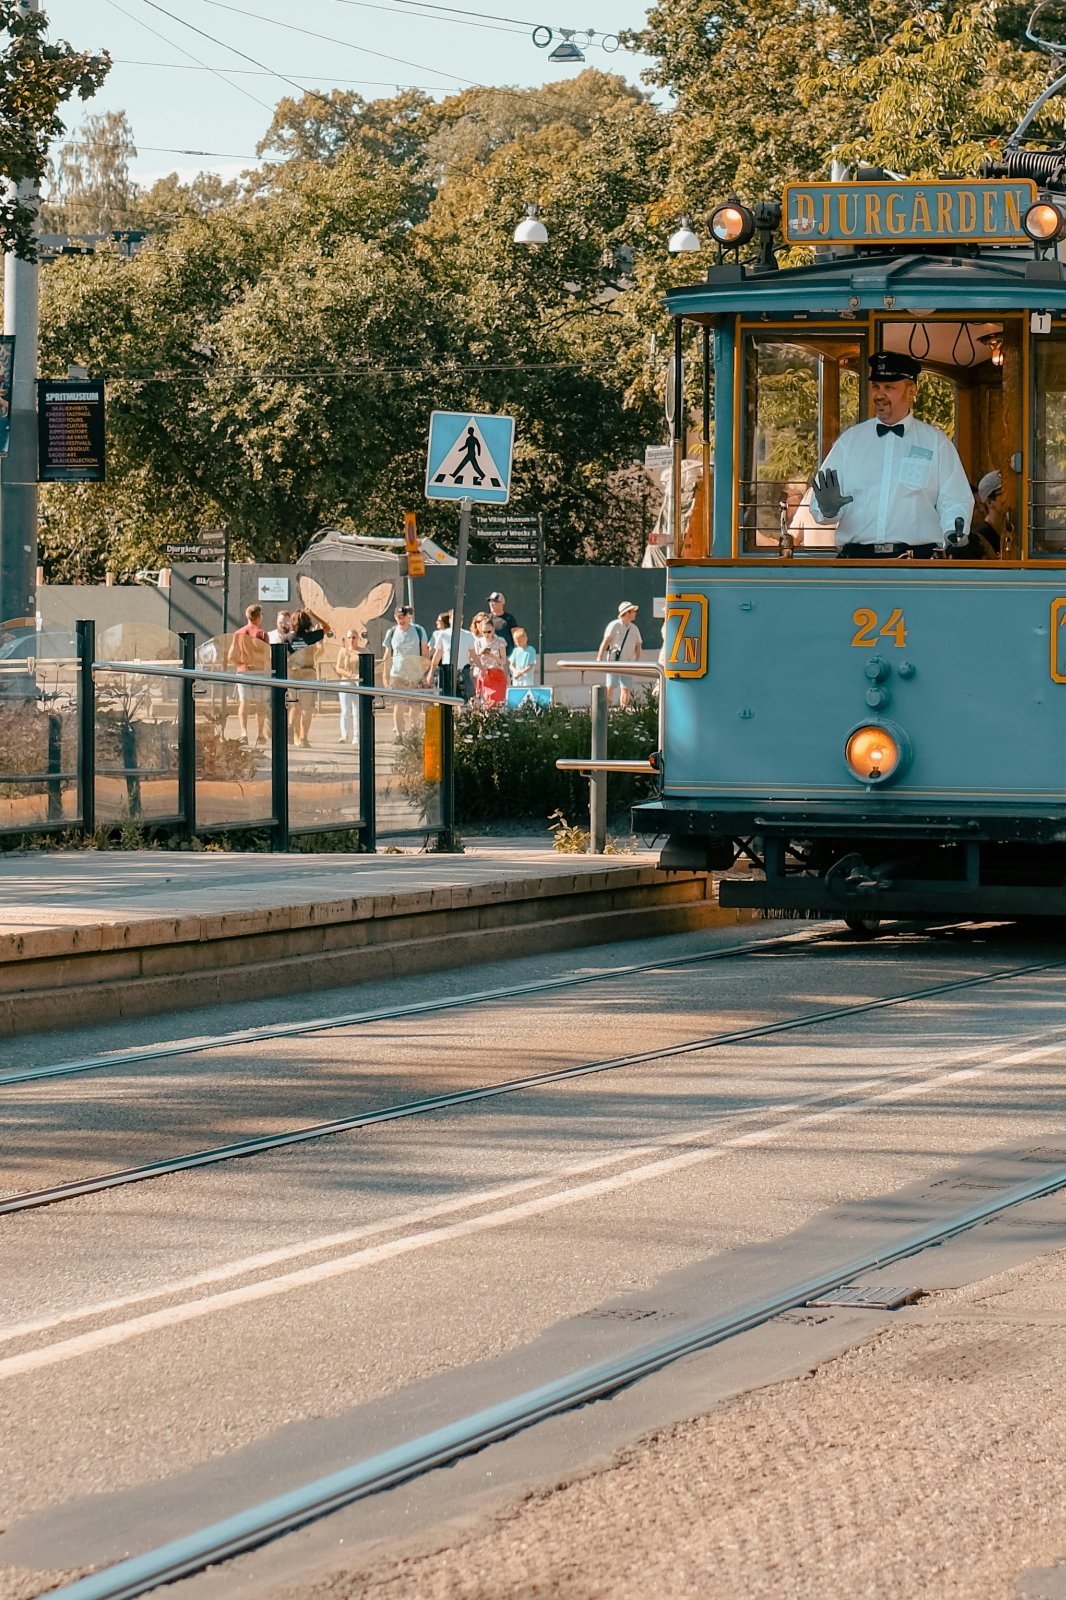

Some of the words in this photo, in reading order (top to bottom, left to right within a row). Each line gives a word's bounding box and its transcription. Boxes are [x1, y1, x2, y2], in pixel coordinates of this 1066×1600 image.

[796, 190, 1024, 237] DJURGÅRDEN
[45, 392, 99, 401] SPRITMUSEUM
[488, 516, 506, 524] Viking
[851, 607, 909, 648] 24
